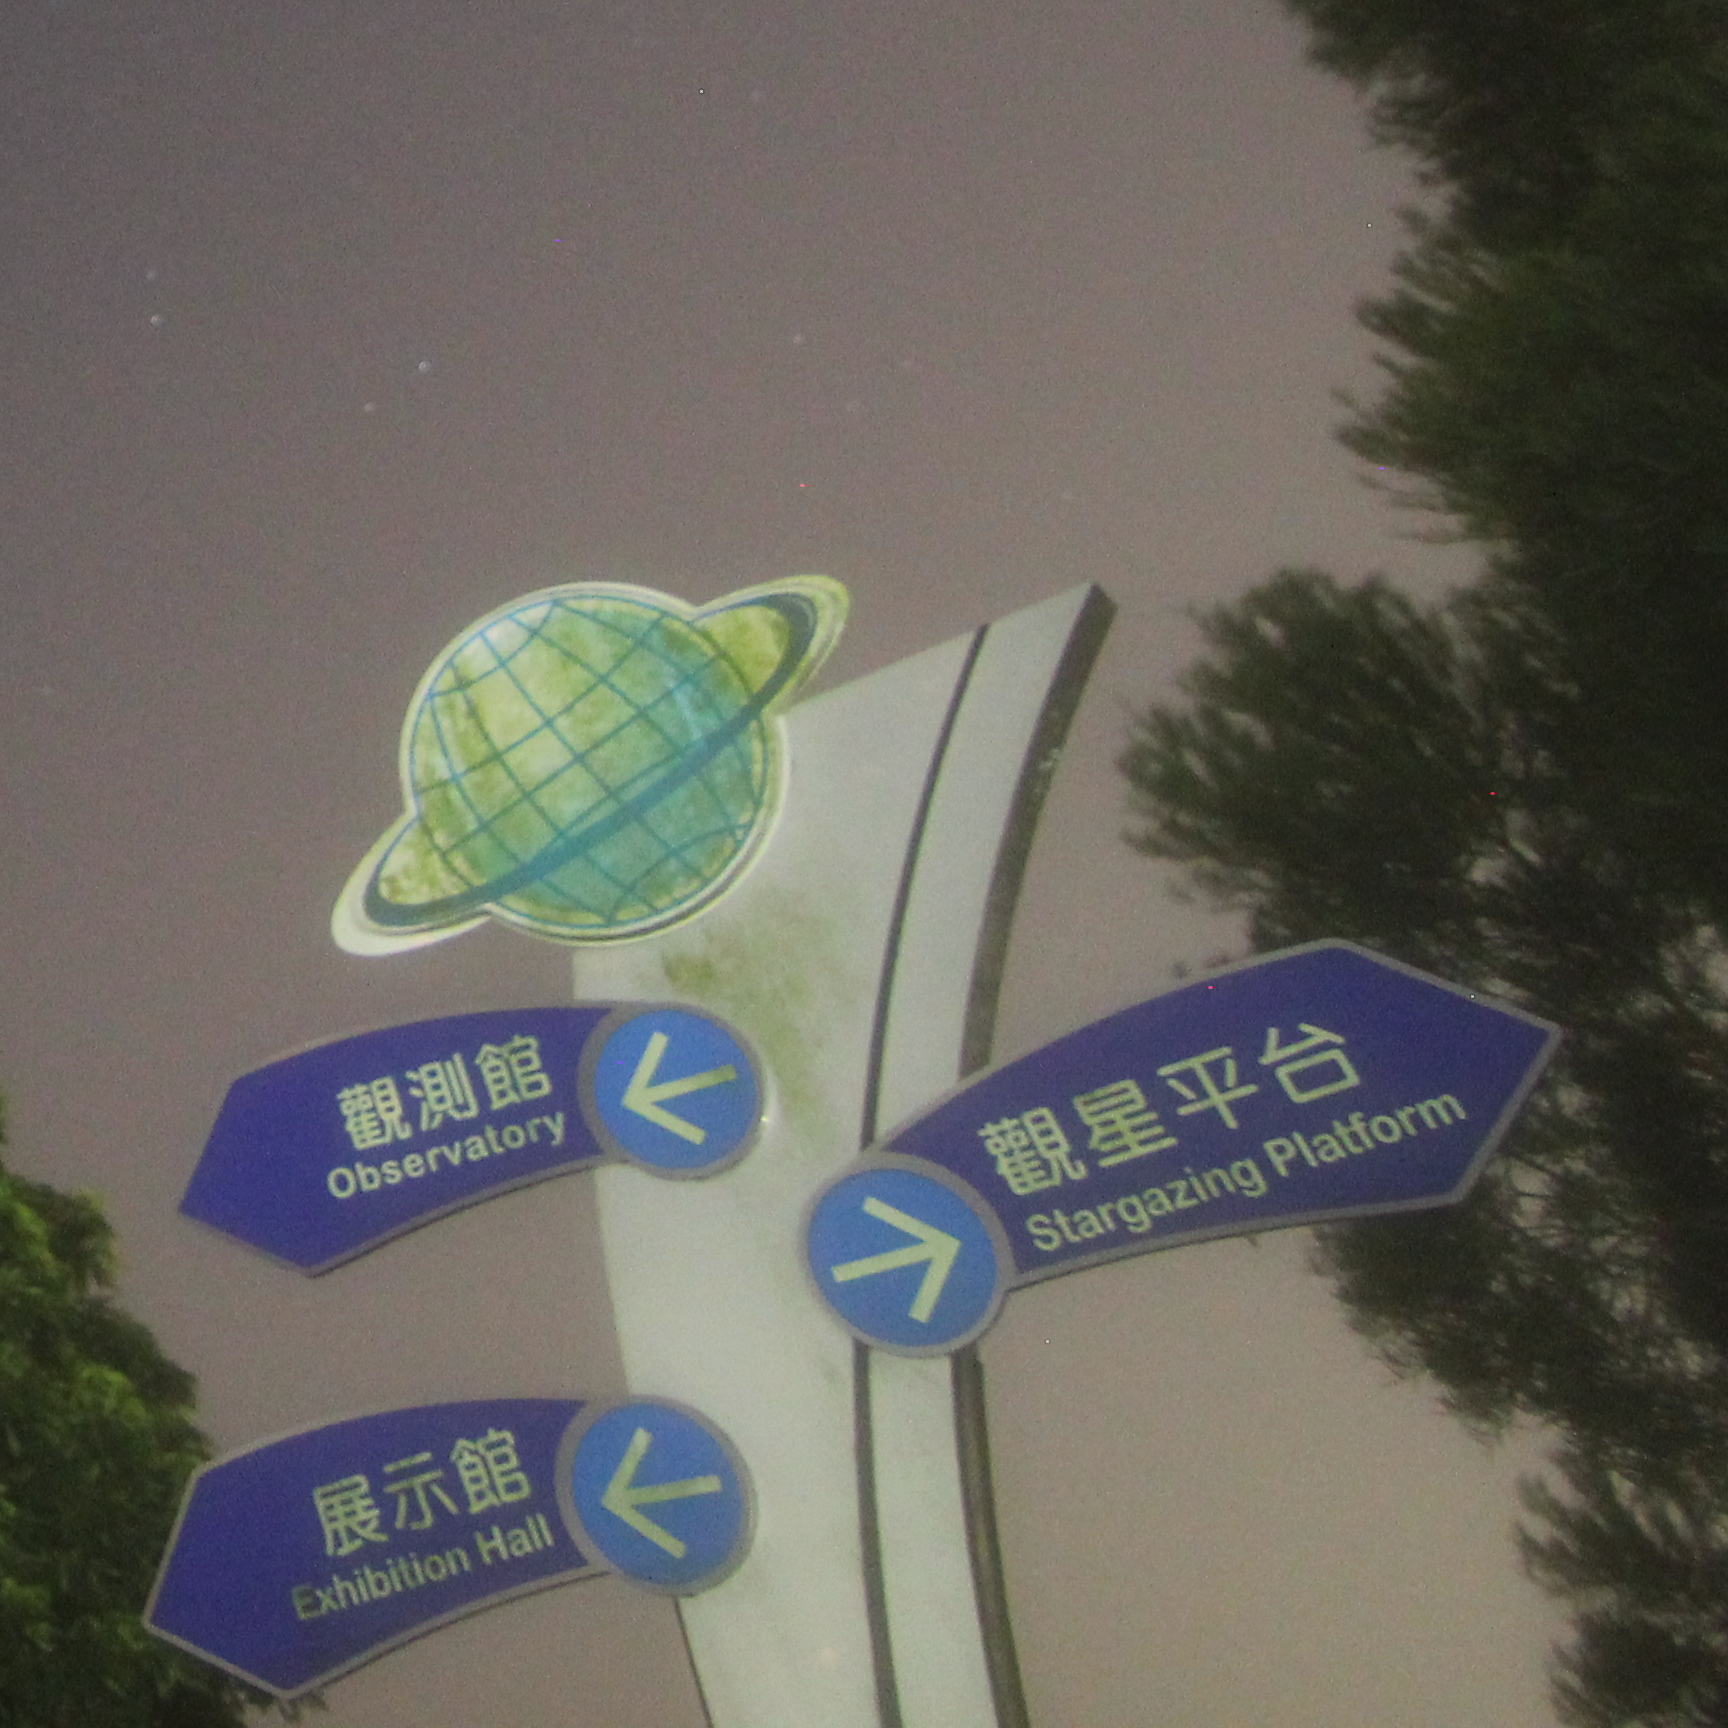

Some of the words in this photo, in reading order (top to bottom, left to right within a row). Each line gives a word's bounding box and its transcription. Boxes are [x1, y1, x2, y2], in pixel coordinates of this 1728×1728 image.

[336, 1034, 552, 1151] 觀測館
[978, 1022, 1361, 1197] 觀星平台
[326, 1111, 566, 1199] Observatory
[1027, 1158, 1267, 1251] Stargazing
[1263, 1092, 1467, 1177] Platform
[312, 1428, 531, 1558] 展示館
[291, 1545, 471, 1620] Exhibition
[476, 1511, 554, 1564] Hall
